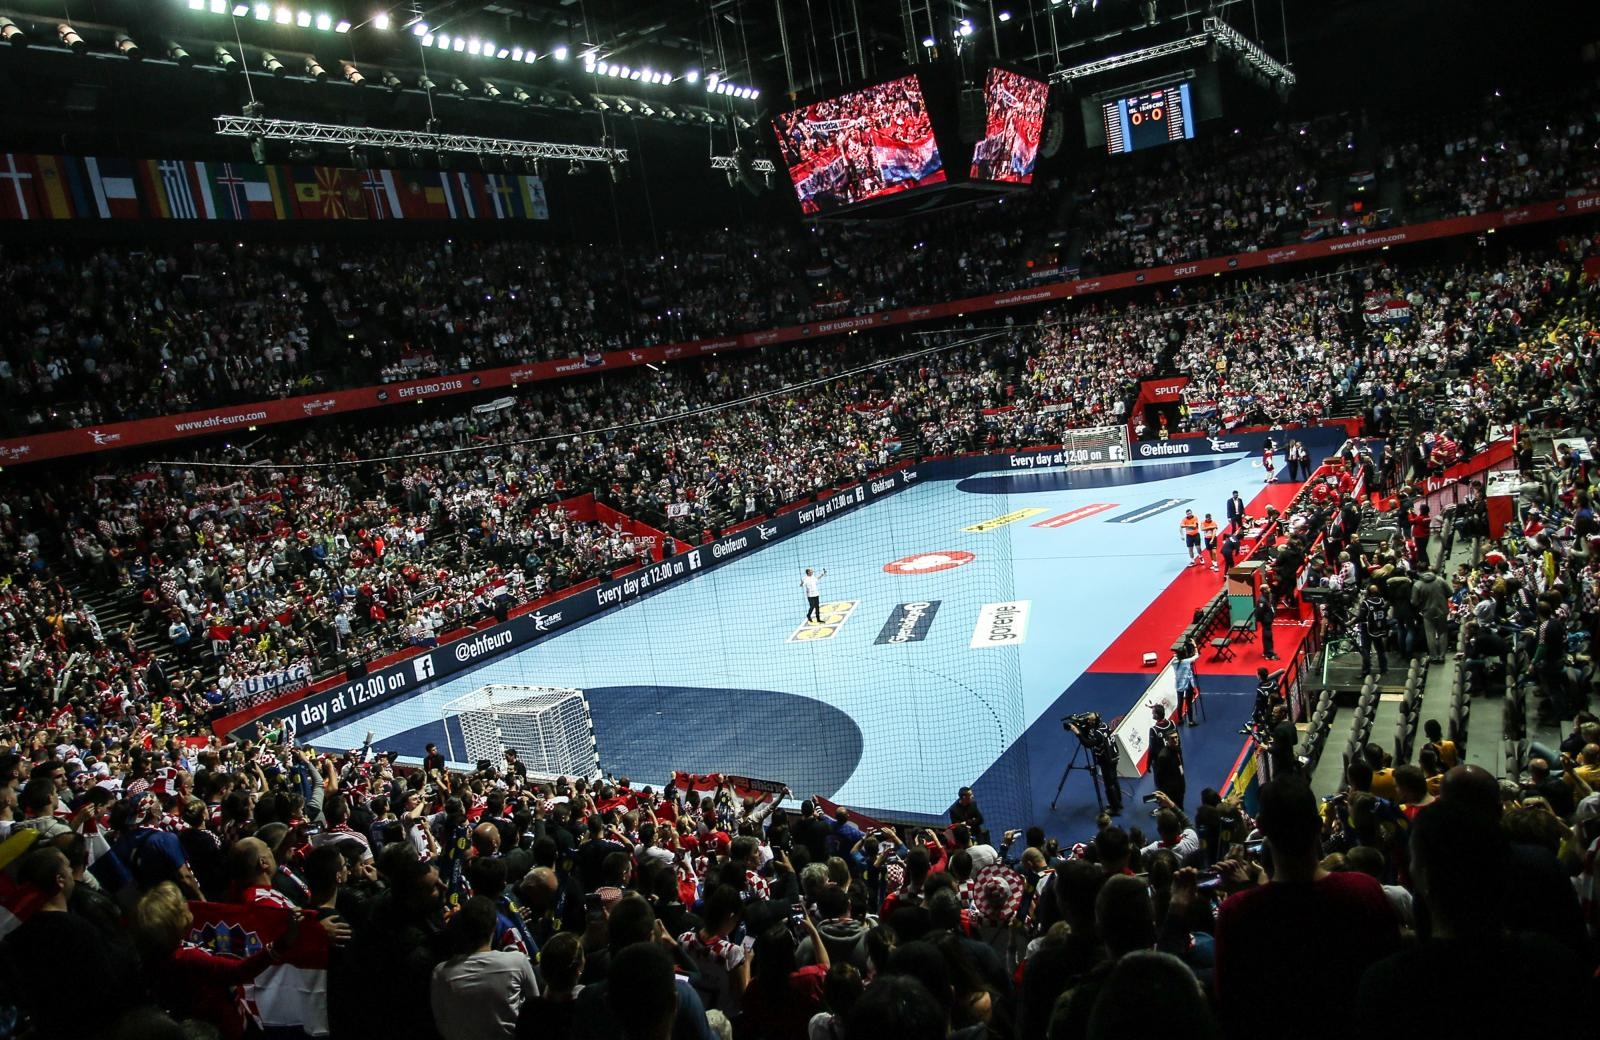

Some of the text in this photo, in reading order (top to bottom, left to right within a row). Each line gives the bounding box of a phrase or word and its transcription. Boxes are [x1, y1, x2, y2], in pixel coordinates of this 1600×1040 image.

[1132, 112, 1142, 125] 0
[1152, 108, 1162, 121] 0
[1330, 233, 1406, 251] www.ehf-euro.com
[1174, 265, 1198, 276] SPLIT
[398, 387, 415, 398] EHF
[416, 383, 440, 395] EURO
[441, 380, 463, 392] 2018
[1154, 385, 1180, 396] SPLIT
[174, 410, 268, 432] www.ehf-euro.com
[1010, 455, 1034, 468] Every
[1036, 452, 1052, 467] day
[1054, 451, 1063, 463] at
[1090, 450, 1102, 460] on
[1140, 442, 1190, 457] @ehfeuro
[798, 511, 815, 524] Every
[815, 504, 826, 518] day
[832, 494, 847, 510] 12:00
[634, 536, 656, 544] EURO
[712, 536, 748, 558] @ehfeuro
[596, 584, 622, 606] Every
[623, 576, 640, 596] day
[640, 571, 651, 588] at
[650, 562, 673, 584] 12:00
[673, 561, 684, 575] on
[988, 605, 1021, 641] gorenje
[455, 629, 513, 662] @ehfeuro
[244, 666, 305, 693] UMAG
[300, 702, 327, 726] day
[331, 693, 347, 714] at
[347, 674, 386, 706] 12:00
[388, 672, 406, 690] on
